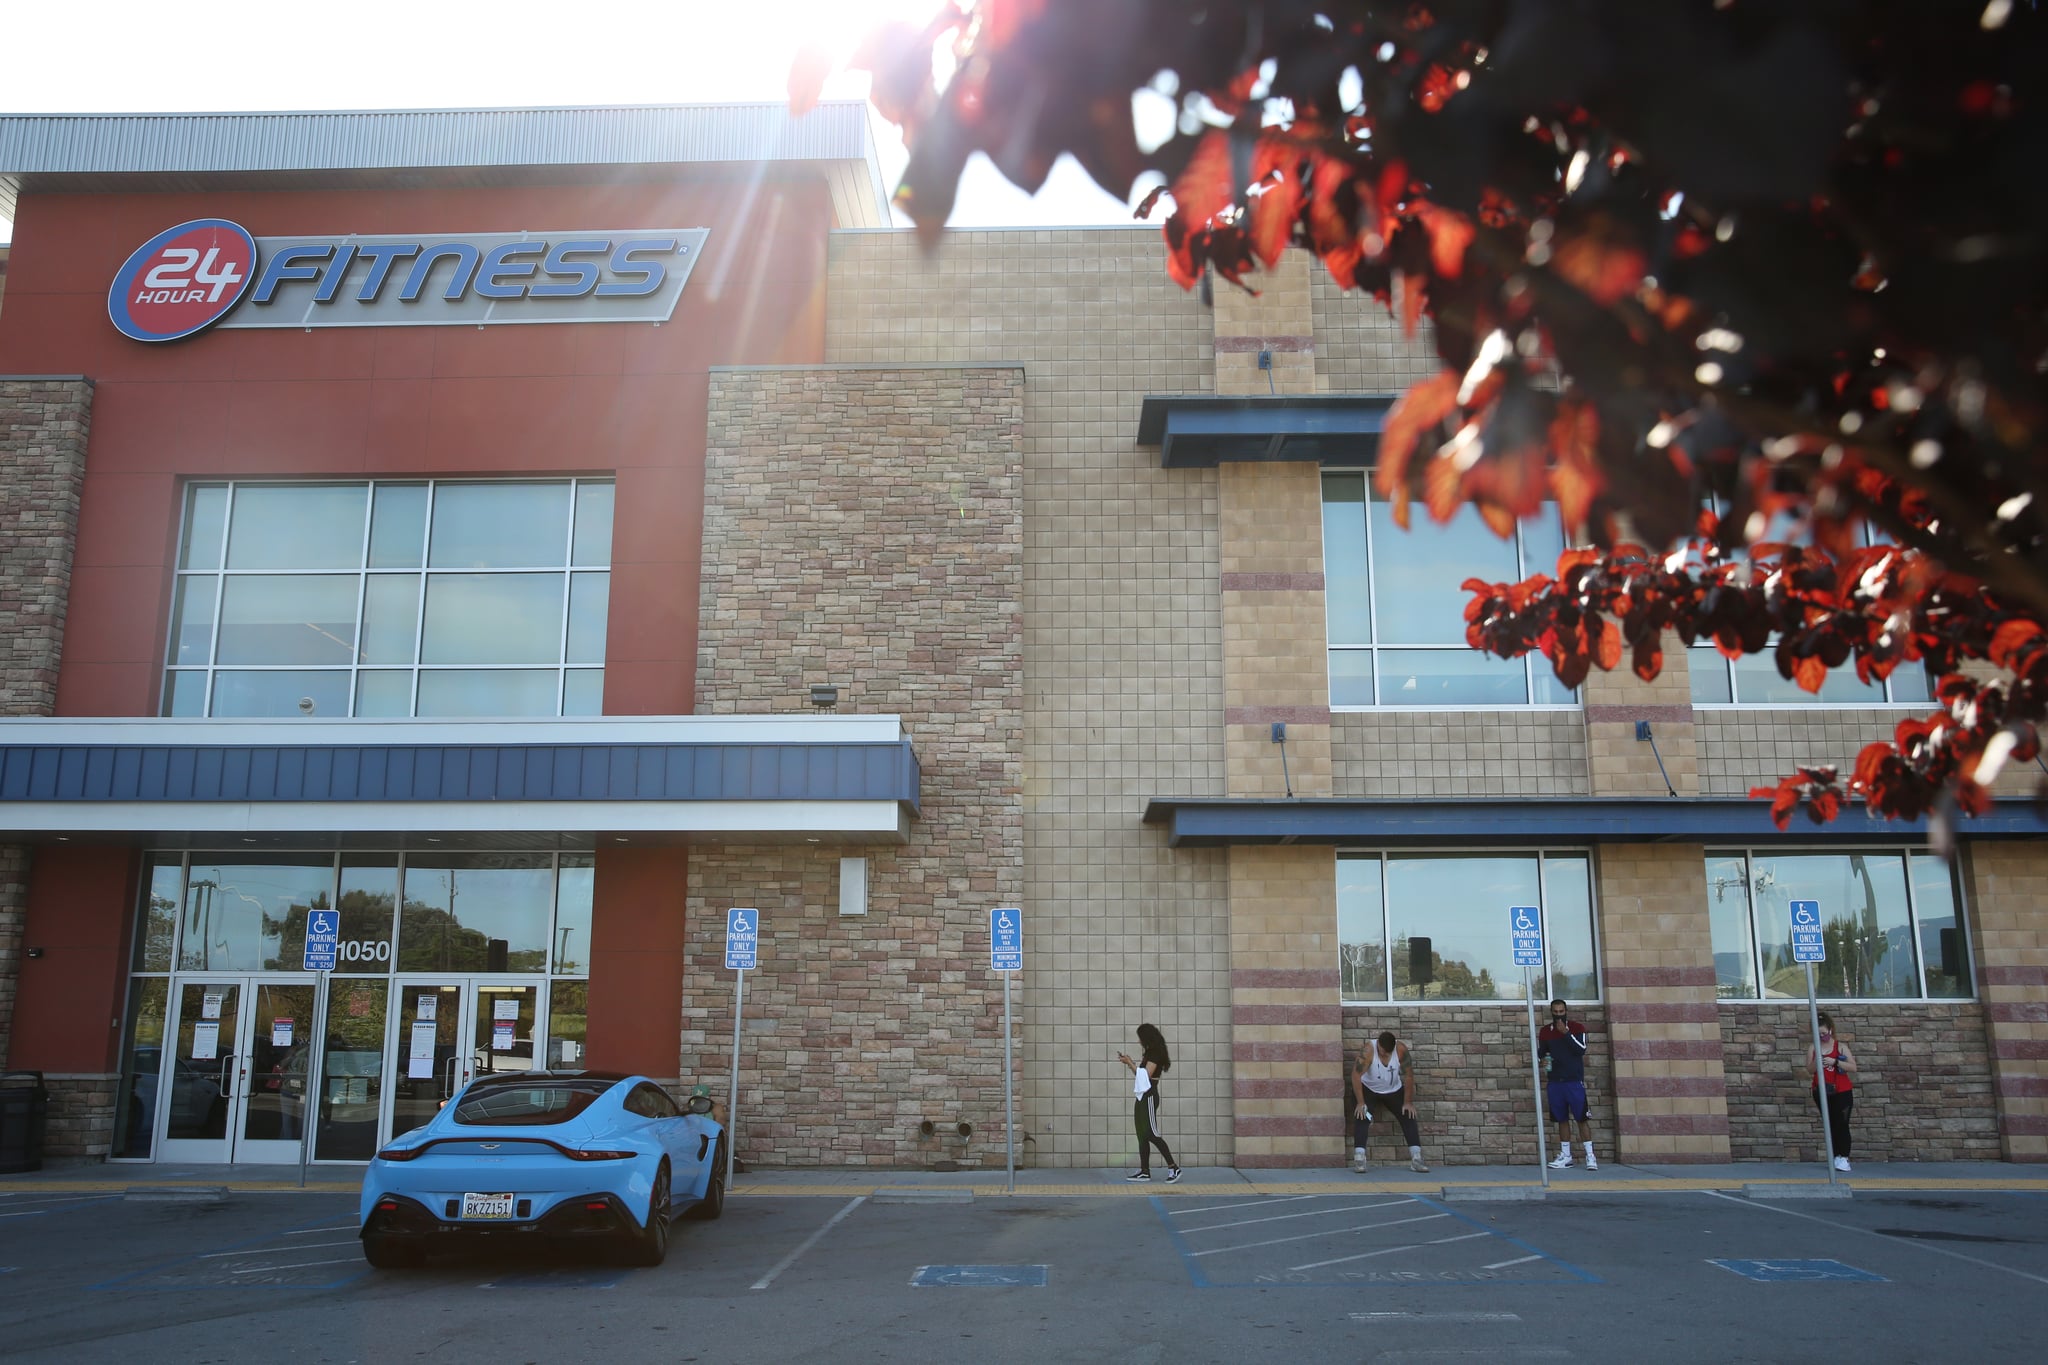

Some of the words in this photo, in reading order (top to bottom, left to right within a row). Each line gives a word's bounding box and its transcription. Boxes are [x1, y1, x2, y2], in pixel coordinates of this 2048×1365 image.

[144, 247, 242, 303] 24
[251, 238, 678, 303] FITNESS
[135, 290, 206, 304] HOUR
[1793, 924, 1820, 933] PARKING
[308, 933, 336, 943] PARKING
[729, 932, 755, 942] PARKING
[1513, 930, 1539, 939] PARKING
[1799, 934, 1816, 943] ONLY
[312, 943, 330, 952] ONLY
[733, 942, 750, 951] ONLY
[1518, 939, 1535, 948] ONLY
[336, 940, 391, 961] 1050
[466, 1202, 508, 1215] 8KZZ151
